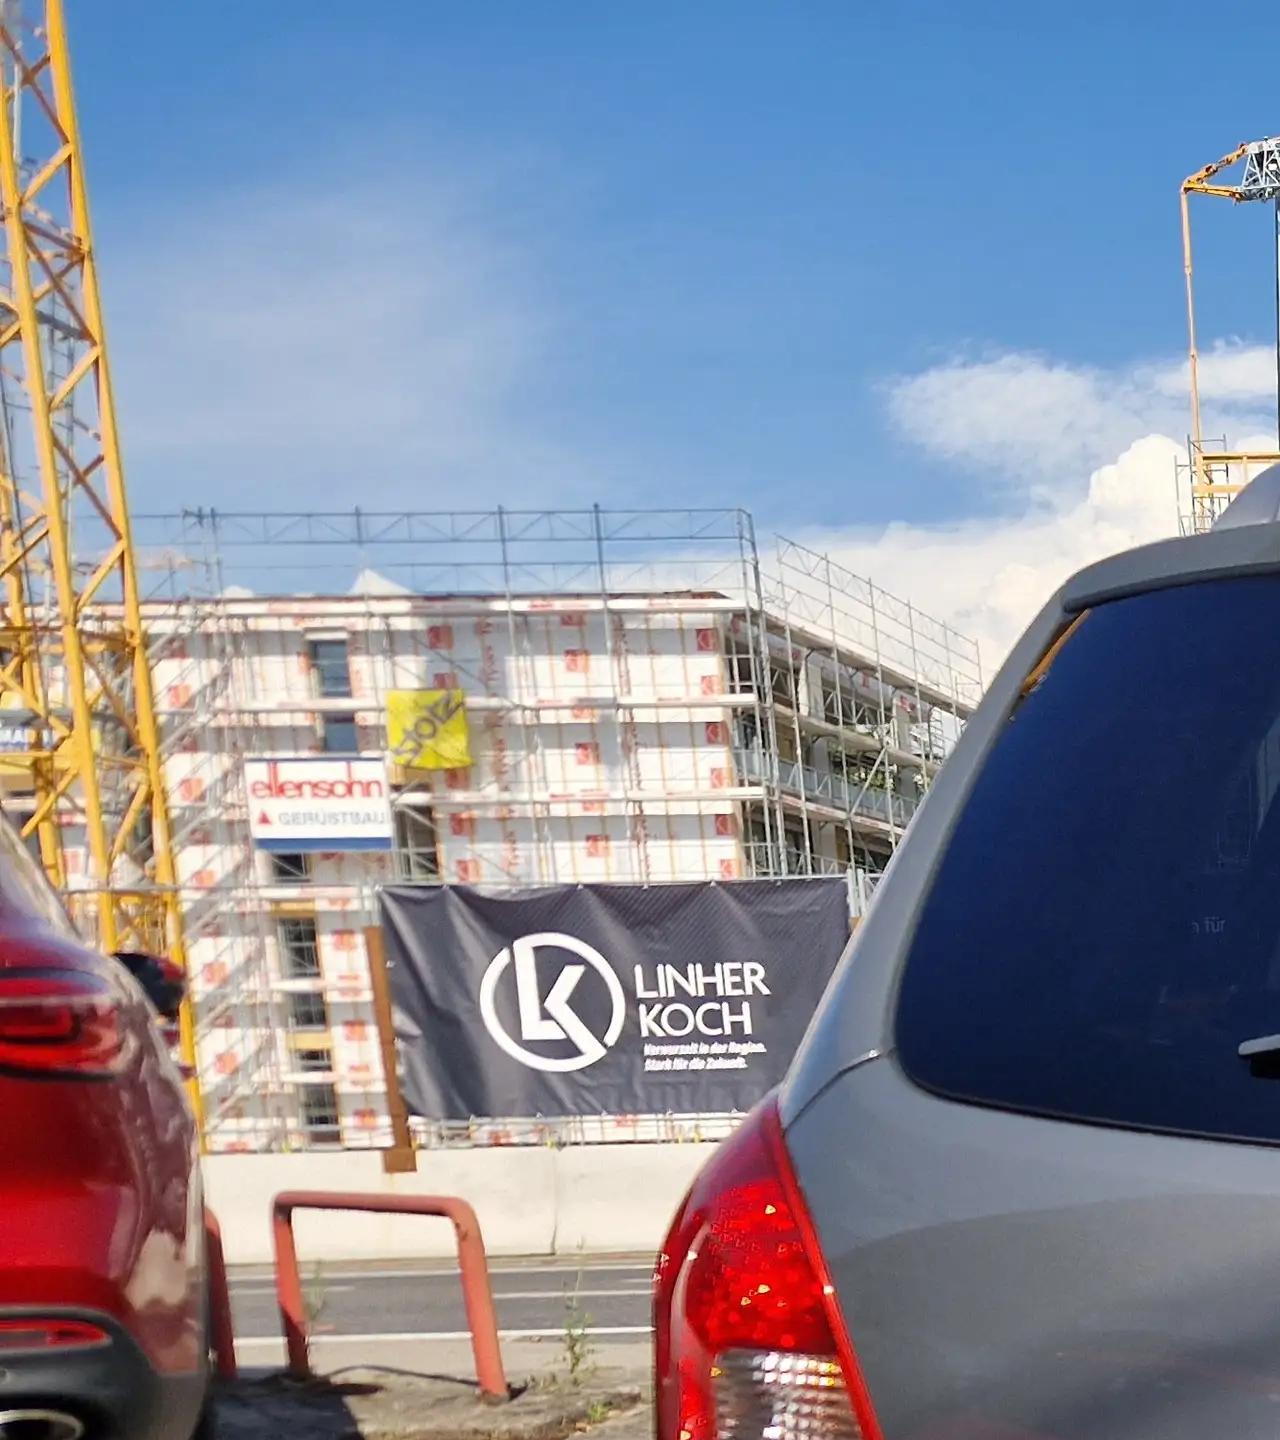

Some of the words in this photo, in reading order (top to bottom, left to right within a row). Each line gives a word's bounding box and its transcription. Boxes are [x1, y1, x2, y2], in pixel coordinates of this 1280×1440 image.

[250, 760, 383, 799] ellensohn
[277, 806, 386, 827] GERÜSTBAU
[634, 962, 772, 998] LINHER
[638, 1001, 753, 1037] KOCH
